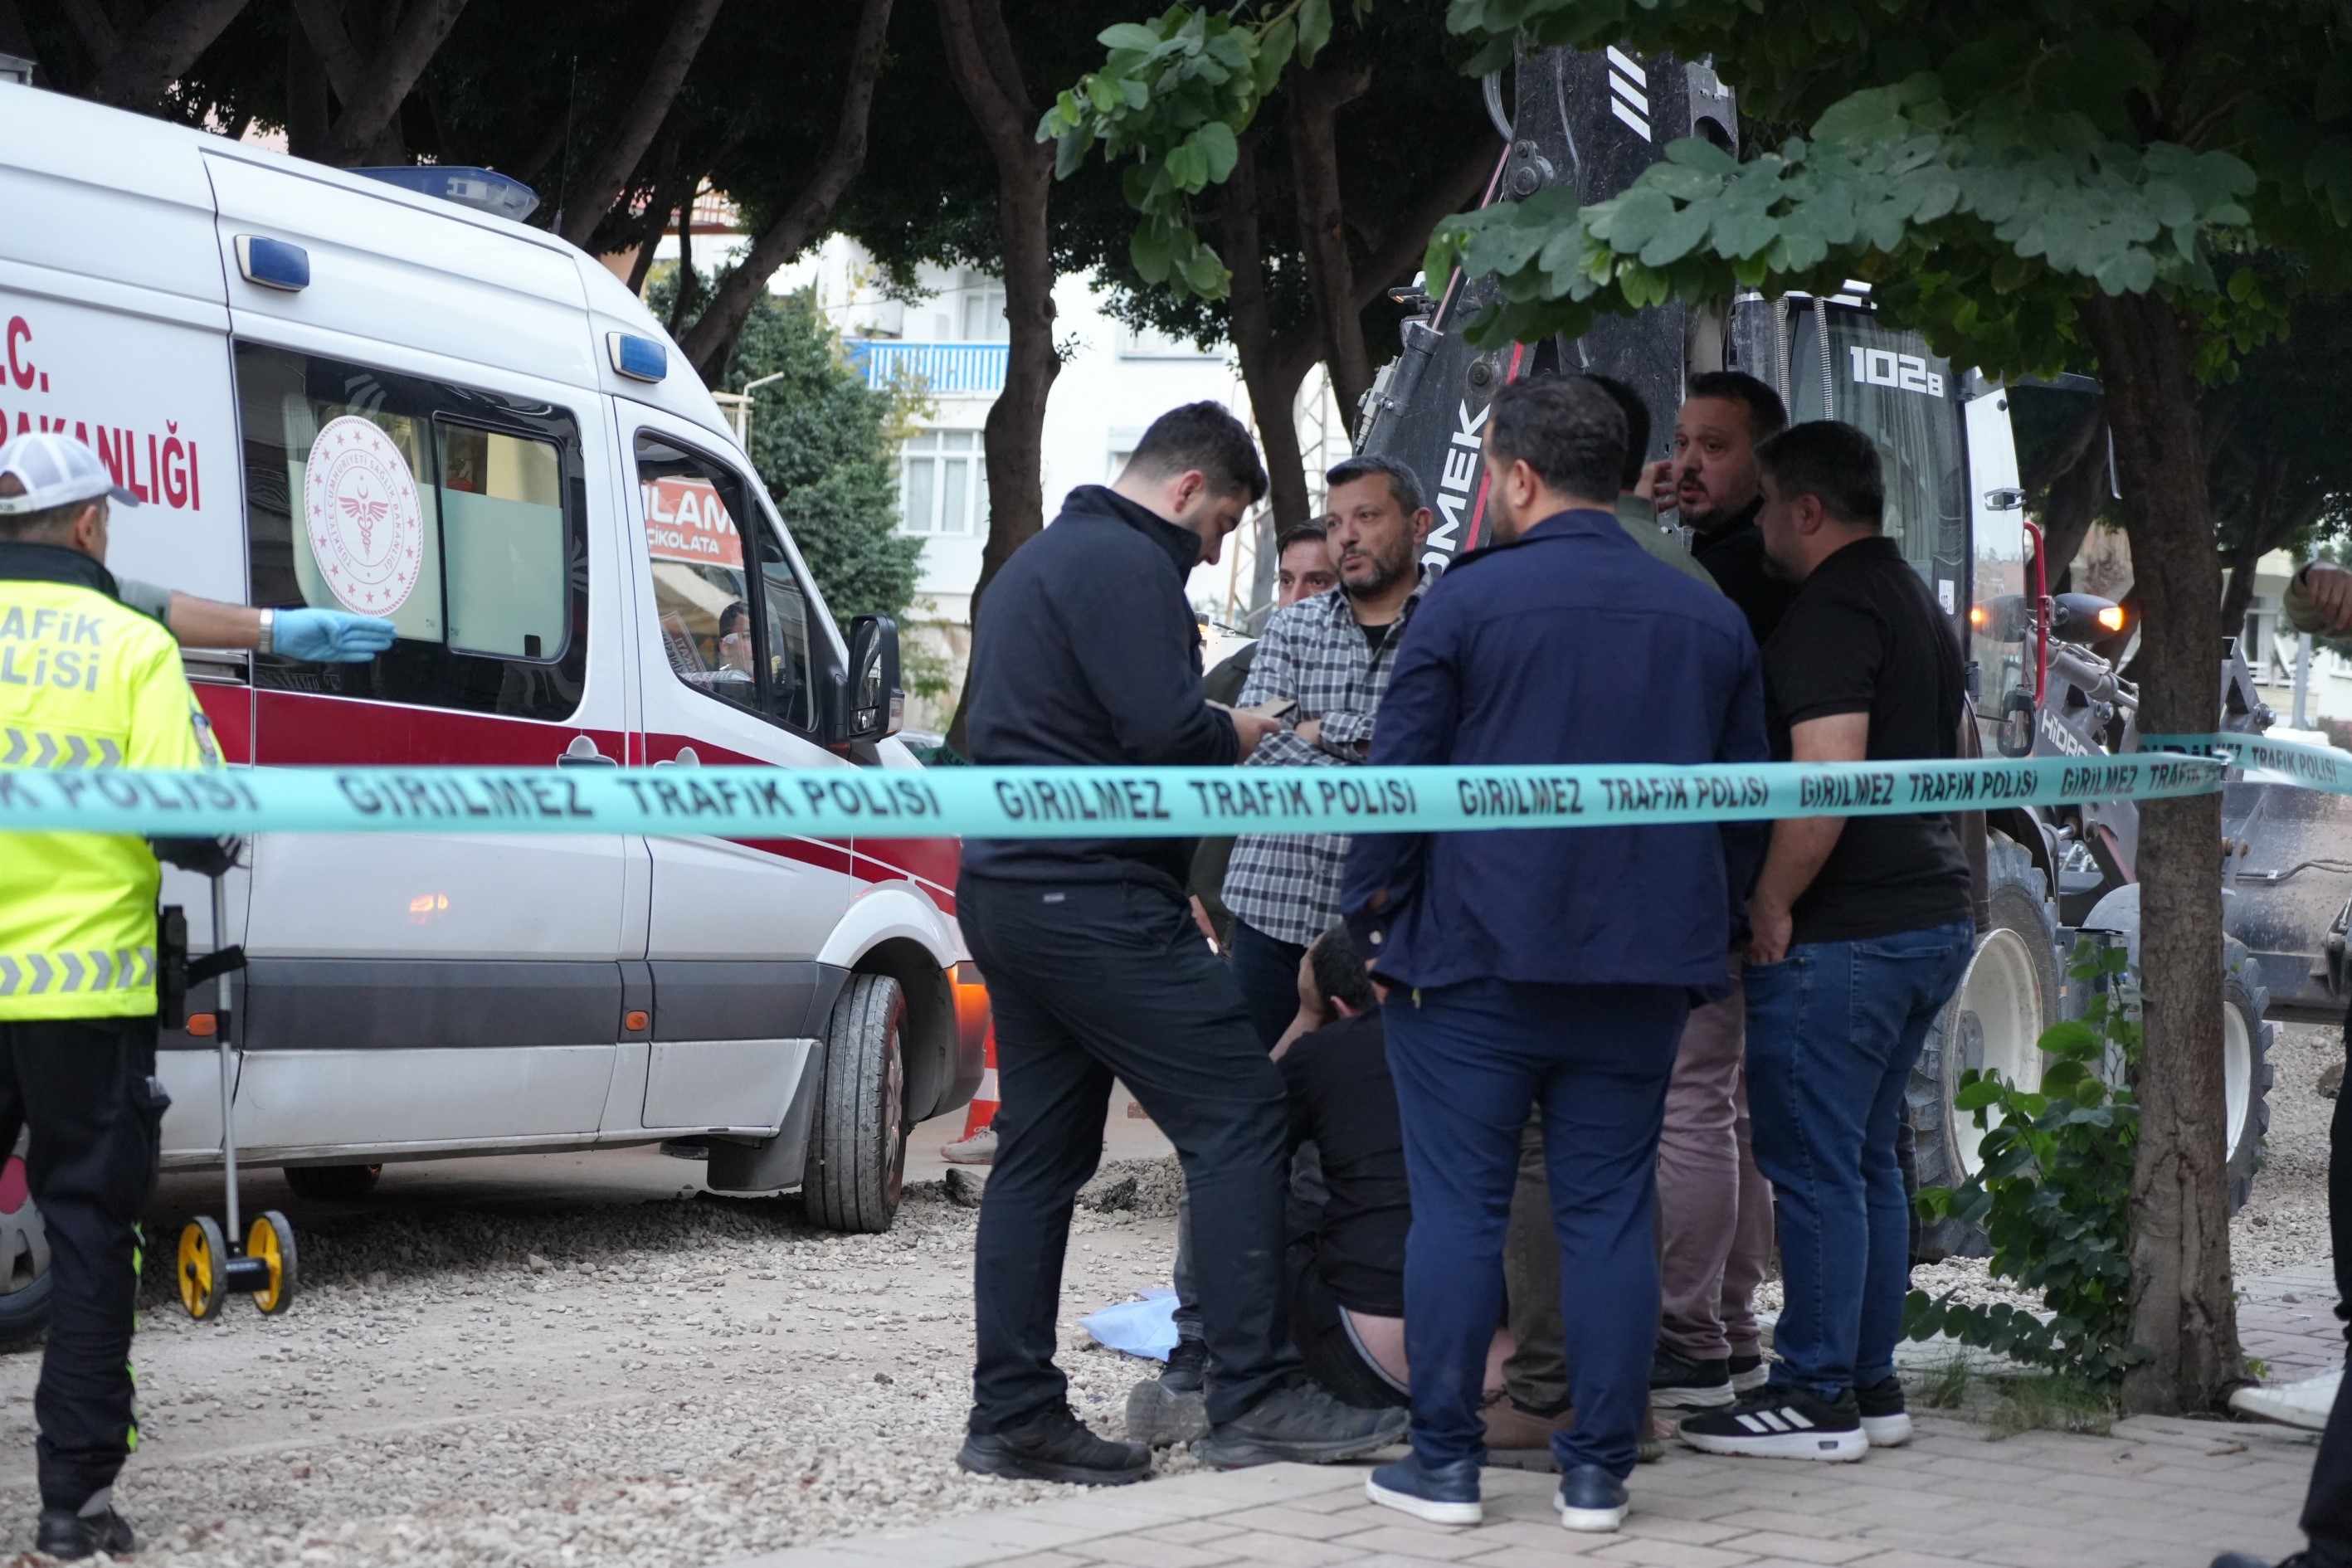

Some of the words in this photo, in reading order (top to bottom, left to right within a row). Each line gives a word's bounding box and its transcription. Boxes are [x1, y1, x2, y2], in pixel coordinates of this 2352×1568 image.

[0, 315, 49, 393] .C.
[1850, 345, 1944, 397] 102B
[0, 606, 104, 646] AFİK
[1, 646, 100, 693] LİSİ
[2252, 746, 2297, 777] TRAFİK
[2298, 752, 2338, 784] POLİSİ
[616, 777, 795, 817] TRAFİK
[797, 777, 941, 816] POLİSİ
[995, 778, 1171, 821] GİRİLMEZ
[1188, 779, 1312, 816] TRAFİK
[1317, 778, 1417, 815] POLİSİ
[1457, 776, 1585, 816] GİRİLMEZ
[1600, 777, 1689, 811] TRAFİK
[1693, 773, 1770, 810] POLİSİ
[1799, 772, 1895, 808] GİRİLMEZ
[1909, 771, 1976, 802] TRAFİK
[1979, 768, 2038, 799] POLİSİ
[2060, 764, 2139, 797] GİRİLMEZ
